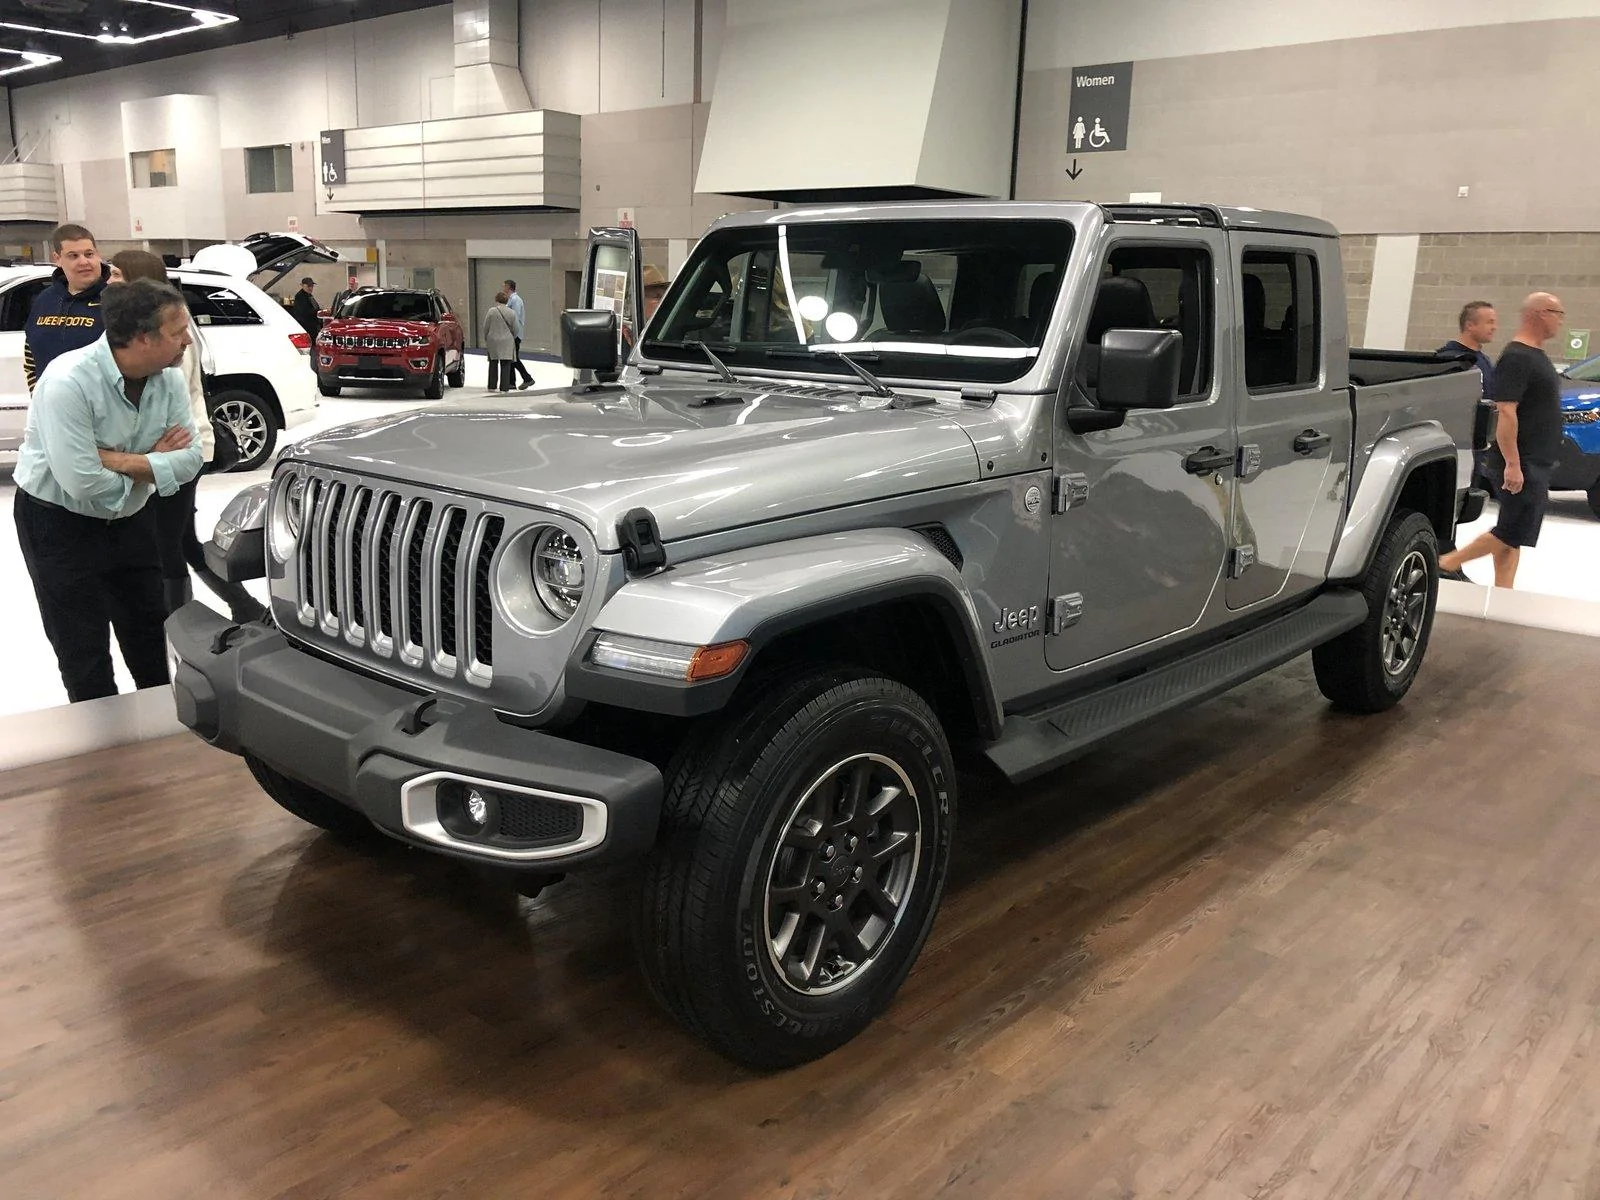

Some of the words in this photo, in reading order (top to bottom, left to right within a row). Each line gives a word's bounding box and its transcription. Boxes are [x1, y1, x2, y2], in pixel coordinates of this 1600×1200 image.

[1076, 75, 1115, 88] Women
[993, 605, 1040, 633] Jeep
[990, 629, 1040, 649] GLADIATOR
